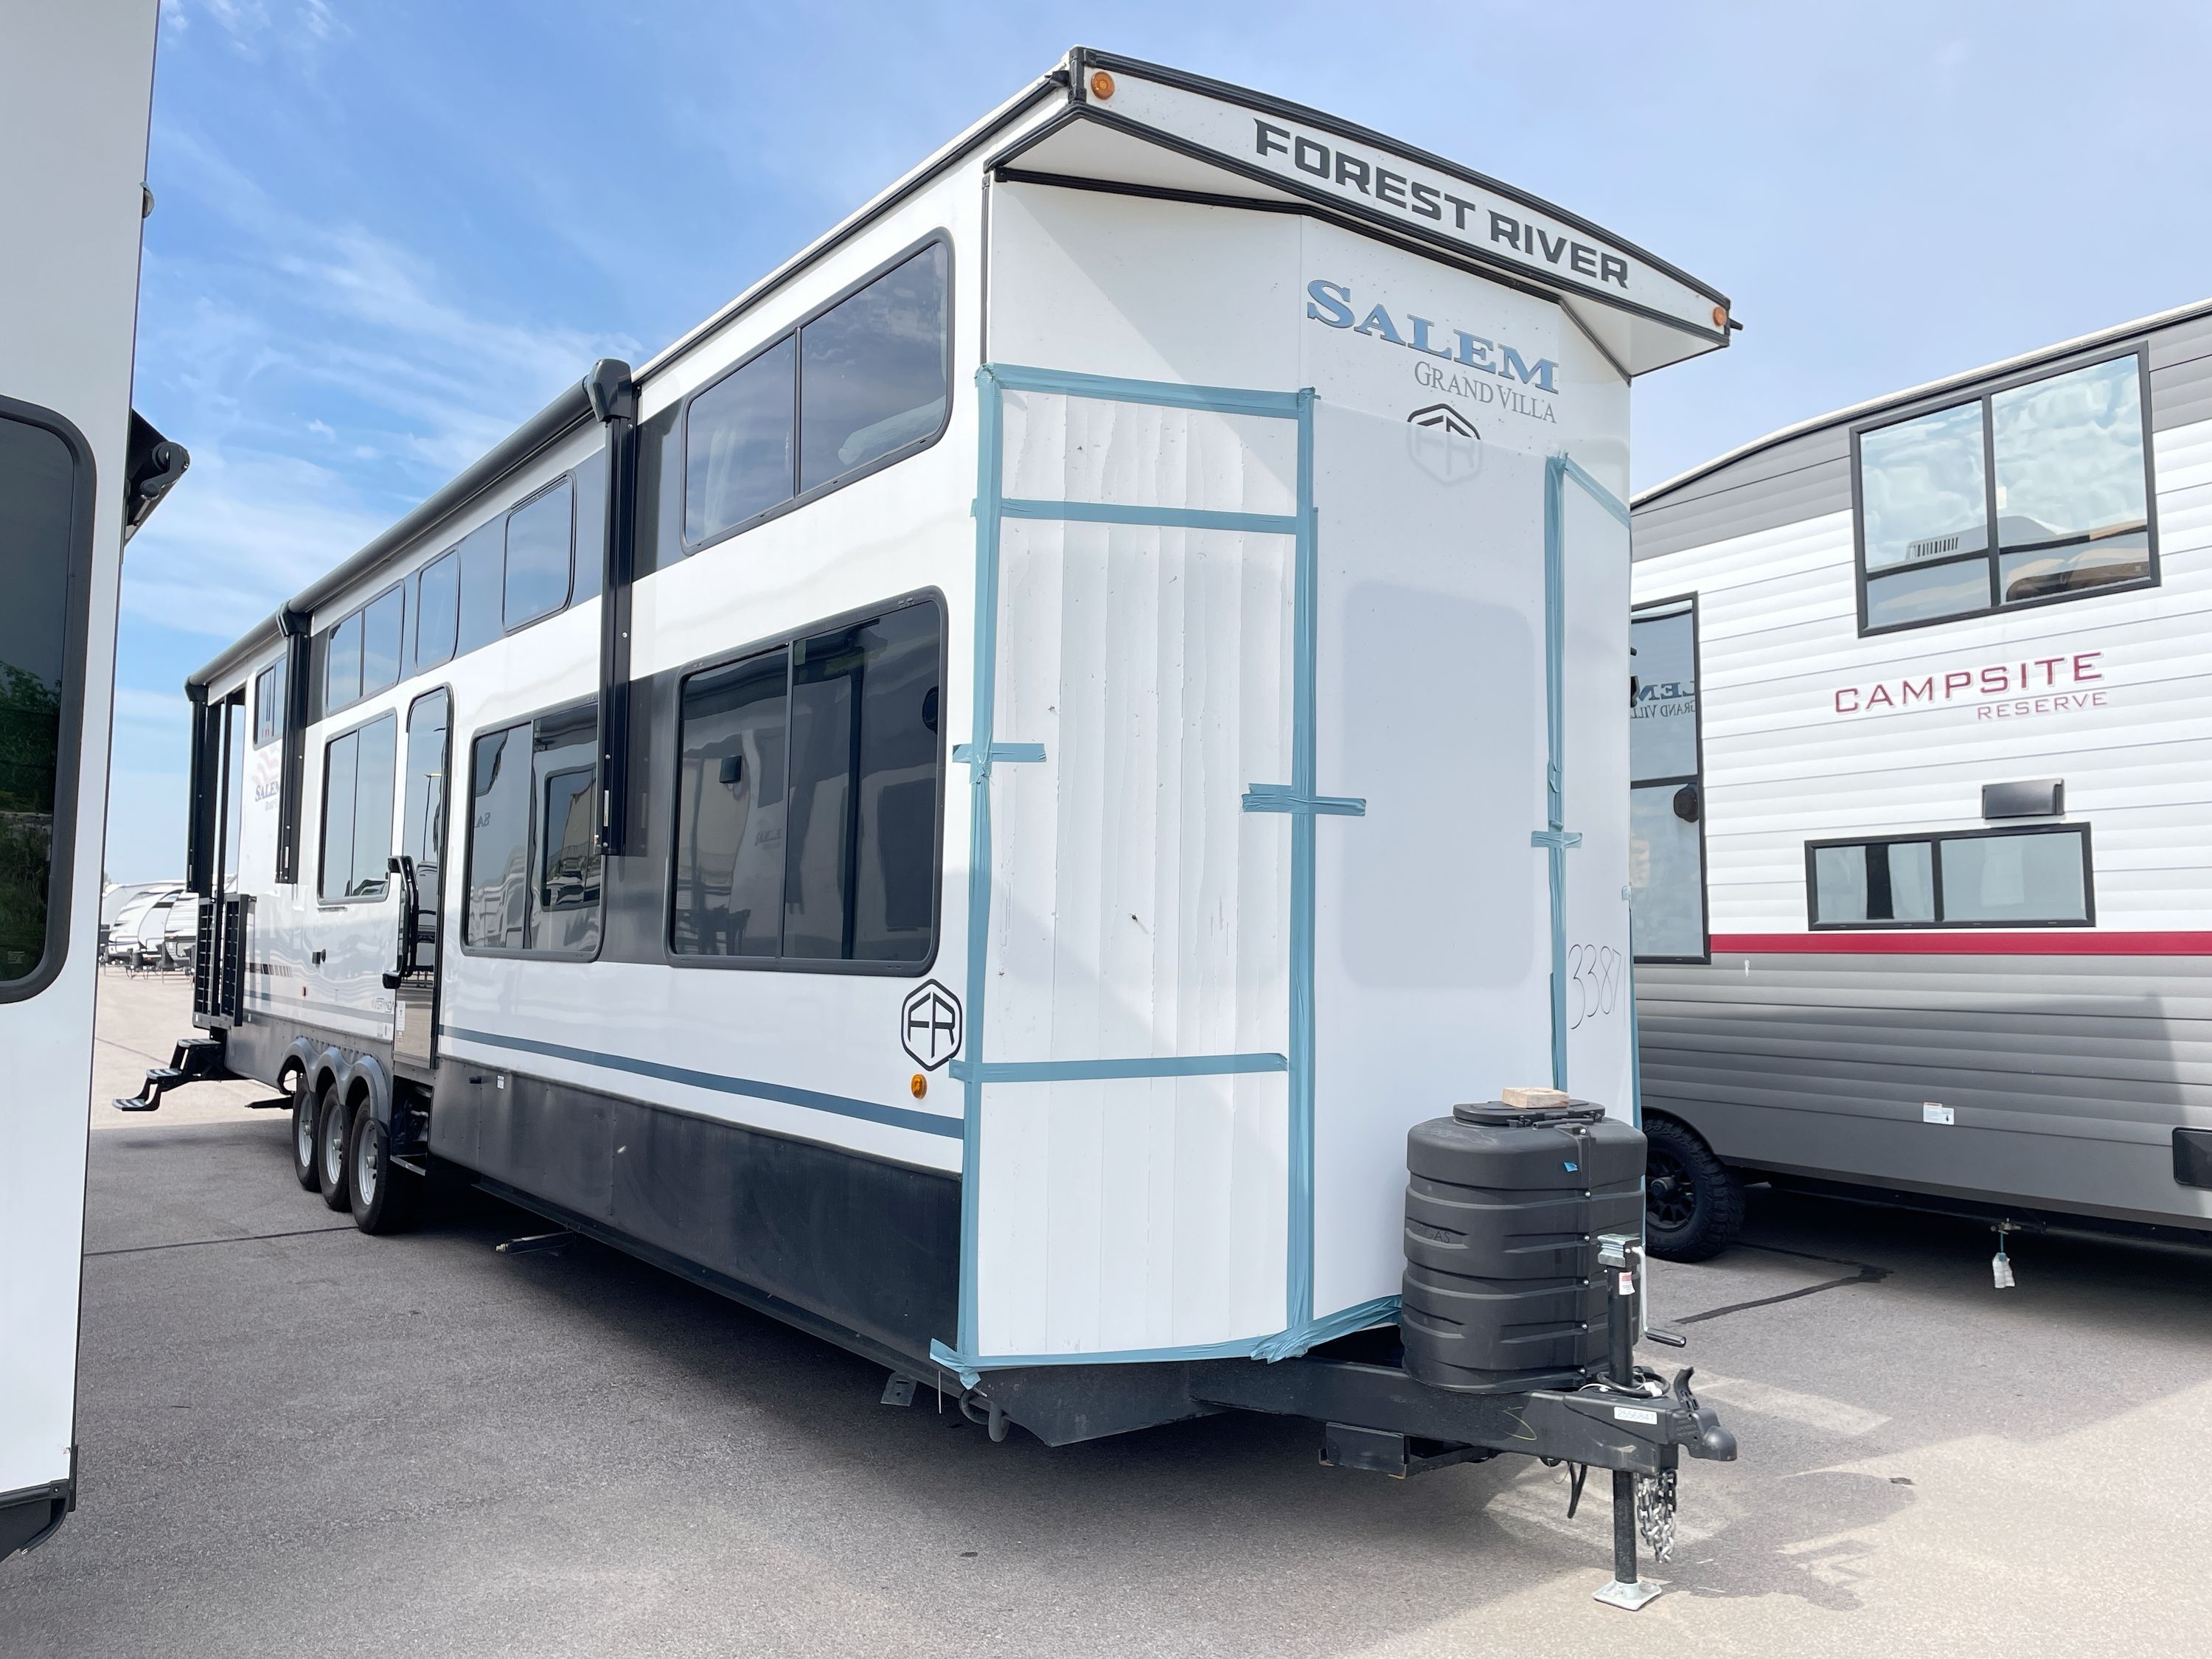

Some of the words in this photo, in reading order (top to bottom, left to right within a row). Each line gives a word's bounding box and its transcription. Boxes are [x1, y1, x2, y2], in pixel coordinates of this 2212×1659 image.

[1254, 118, 1475, 230] FOREST
[1487, 209, 1629, 288] RIVER
[1307, 279, 1559, 394] SALEM
[1414, 361, 1494, 403] GRAND
[1496, 383, 1557, 424] VILLA
[1835, 652, 2102, 712] CAMPSITE
[1978, 692, 2107, 720] RESERVE
